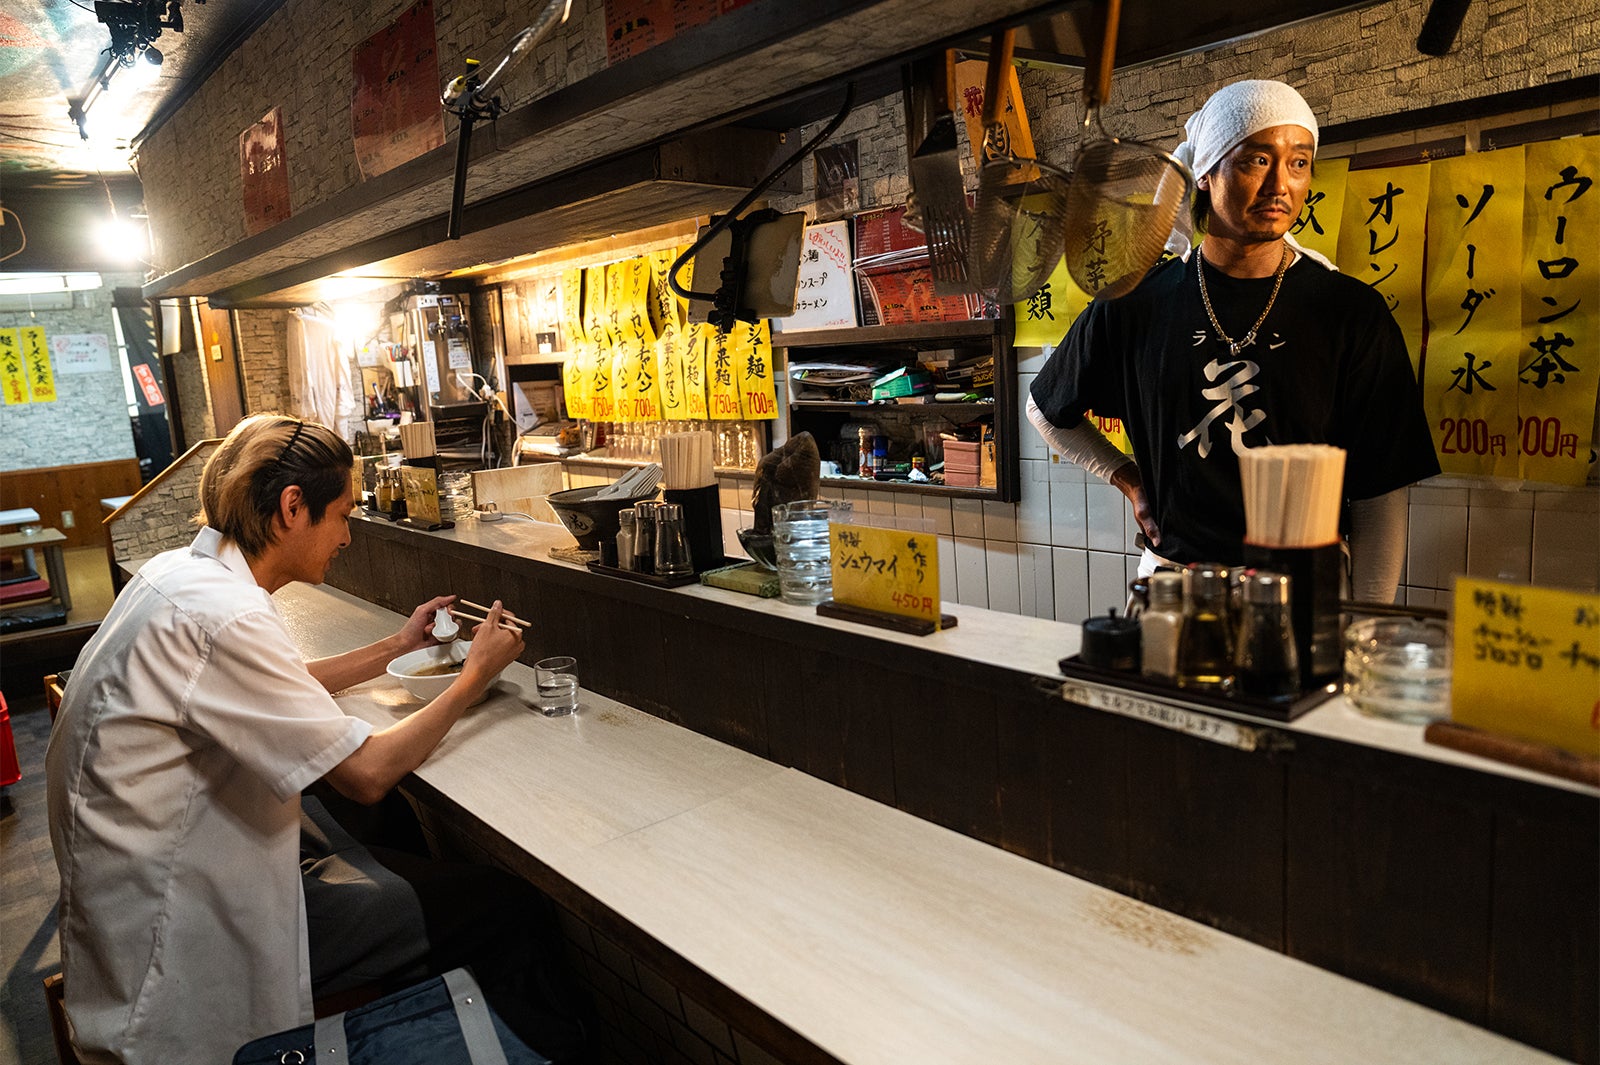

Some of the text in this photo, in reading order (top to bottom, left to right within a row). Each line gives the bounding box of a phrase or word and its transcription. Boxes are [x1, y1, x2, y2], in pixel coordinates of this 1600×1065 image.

[1444, 184, 1497, 395] ソーダ水
[1519, 165, 1593, 389] ウーロン茶
[686, 322, 702, 387] ンタン麺
[746, 324, 766, 381] シュー麺
[634, 398, 657, 417] 700円
[713, 394, 738, 414] 750円
[746, 392, 775, 415] 700円
[1440, 418, 1507, 457] 200円
[1518, 416, 1579, 459] 00円
[840, 550, 898, 578] シュウマイ
[892, 591, 933, 615] 450円
